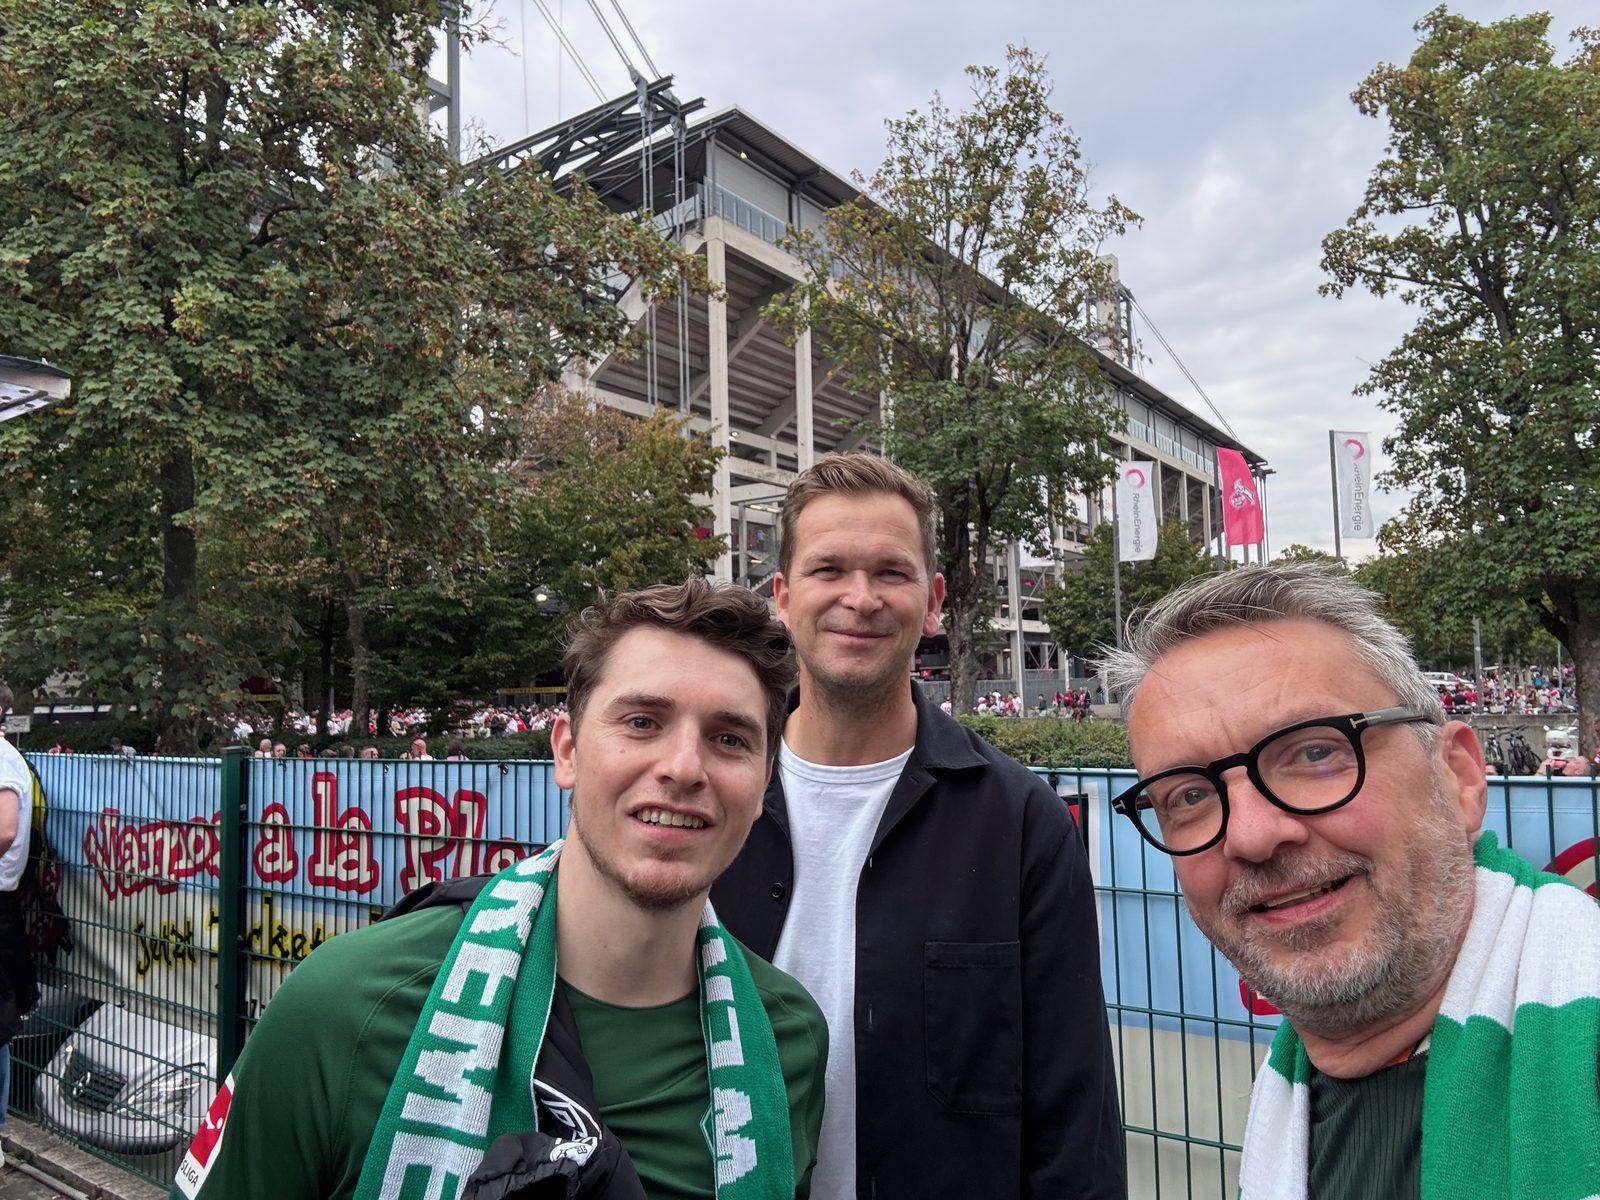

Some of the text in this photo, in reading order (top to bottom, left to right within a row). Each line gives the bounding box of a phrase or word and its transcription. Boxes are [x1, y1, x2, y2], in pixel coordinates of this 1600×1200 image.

[1132, 492, 1143, 553] RheinEnergie
[252, 801, 299, 884] a
[308, 771, 380, 895] la
